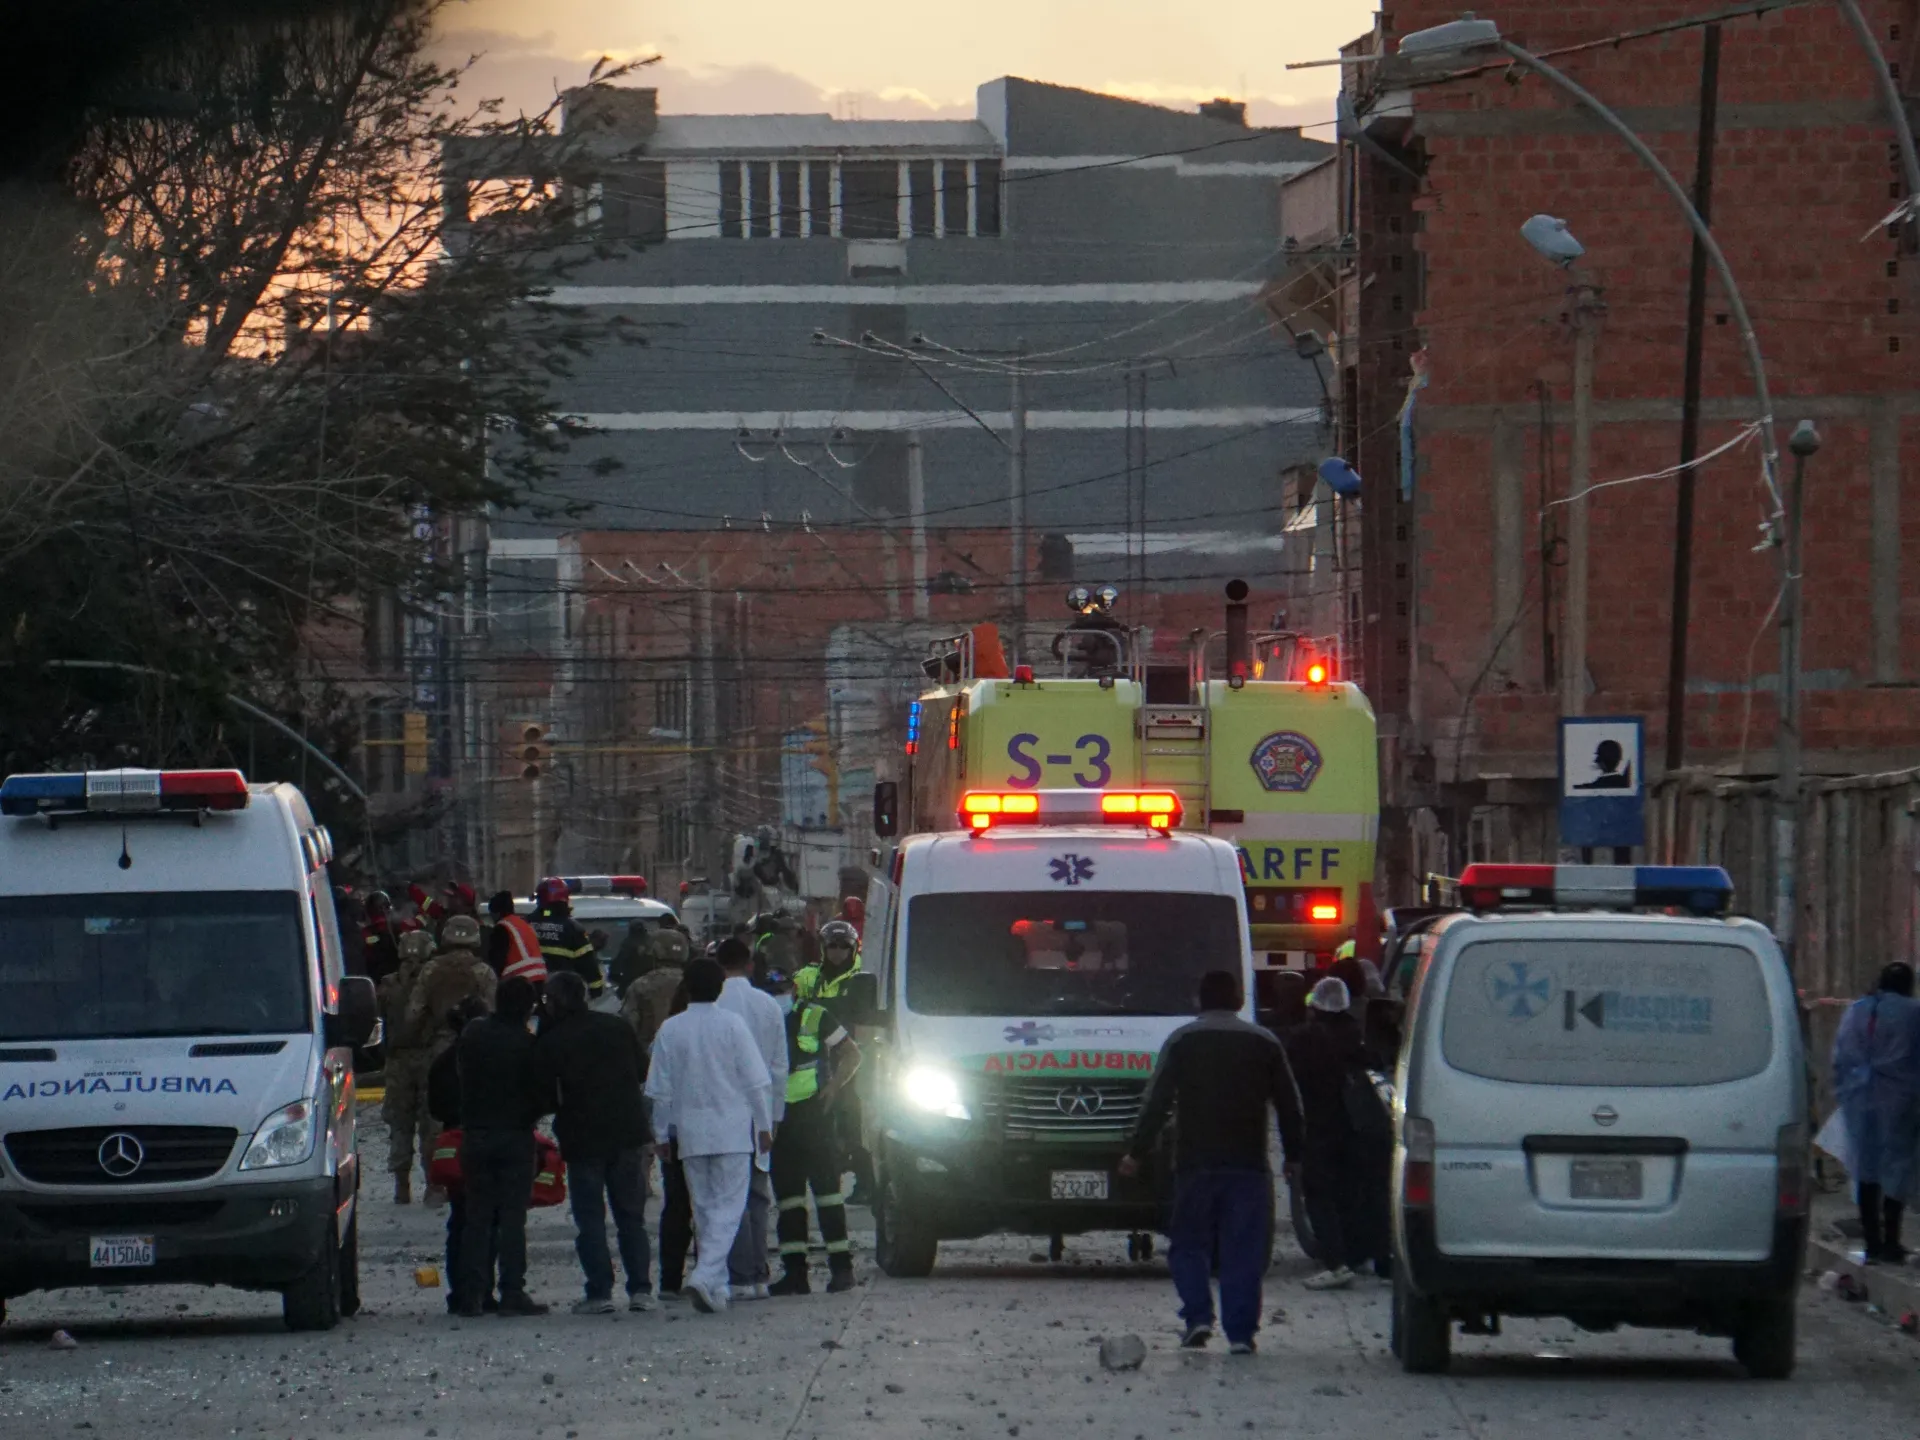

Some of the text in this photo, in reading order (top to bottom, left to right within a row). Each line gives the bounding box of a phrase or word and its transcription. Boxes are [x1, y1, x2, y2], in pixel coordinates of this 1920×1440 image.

[1006, 732, 1112, 790] S-3
[1238, 847, 1341, 881] ARFF
[93, 1245, 151, 1264] 4415DAG
